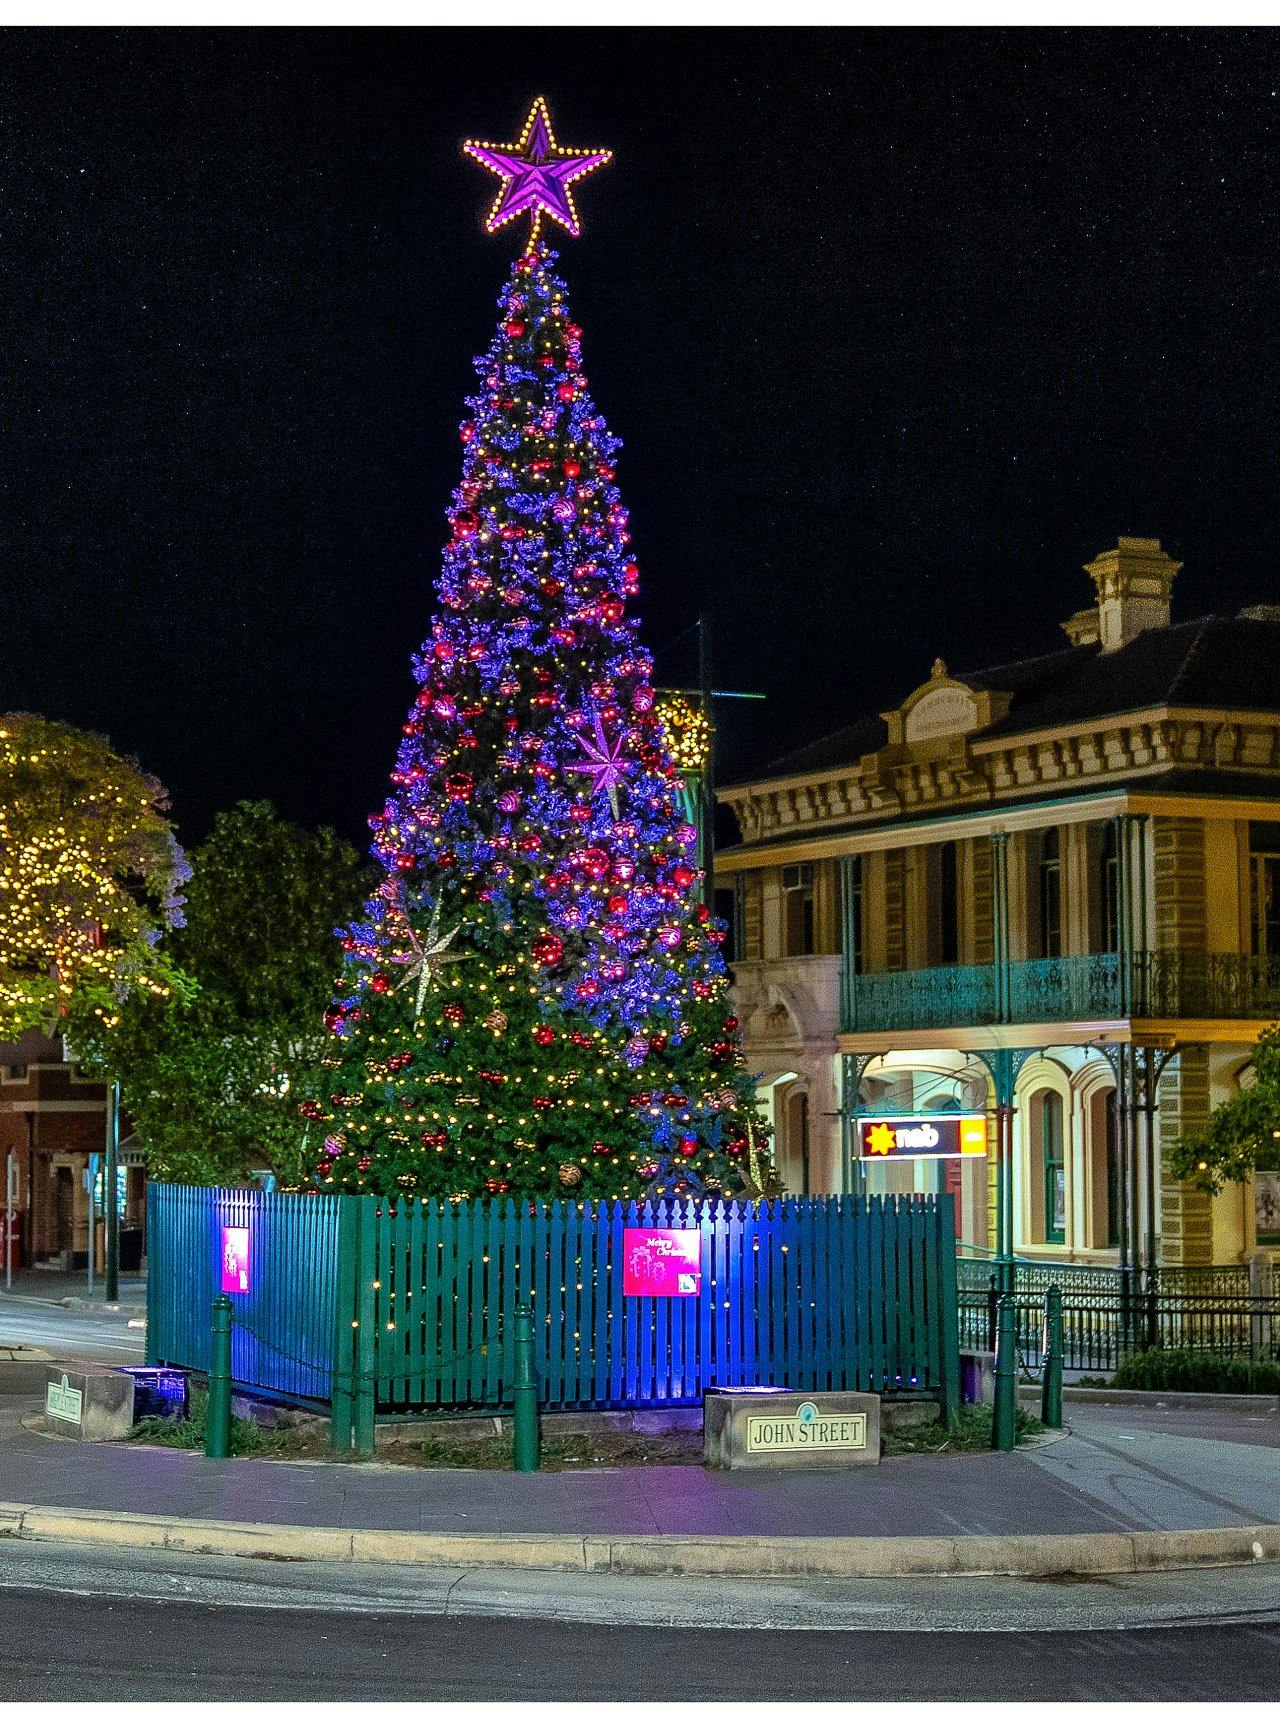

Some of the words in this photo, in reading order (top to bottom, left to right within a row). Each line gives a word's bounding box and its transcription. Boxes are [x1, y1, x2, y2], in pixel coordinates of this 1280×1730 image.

[895, 1123, 939, 1148] nab
[754, 1423, 795, 1444] JOHN
[799, 1422, 860, 1443] STREET
